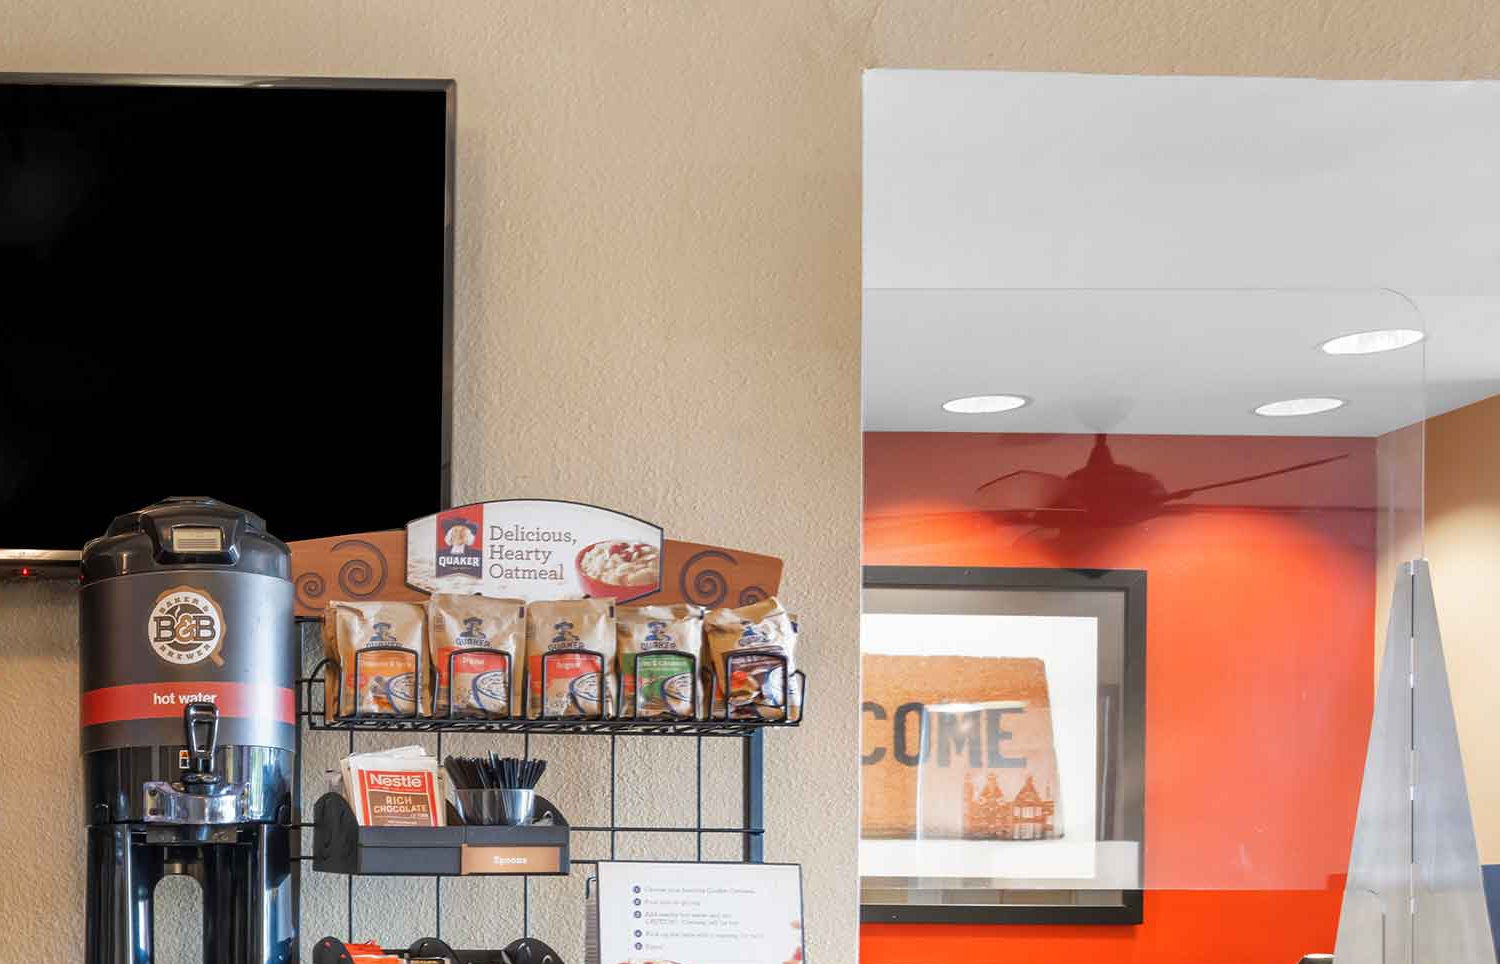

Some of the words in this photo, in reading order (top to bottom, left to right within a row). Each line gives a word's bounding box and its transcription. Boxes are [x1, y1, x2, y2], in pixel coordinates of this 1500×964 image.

[488, 525, 578, 545] Delicious,
[438, 555, 481, 568] QUAKER
[489, 544, 553, 566] Hearty
[488, 563, 565, 581] Oatmeal
[153, 613, 217, 643] B&B
[153, 692, 176, 705] hot
[179, 692, 218, 705] water
[385, 795, 413, 805] RICH
[373, 804, 428, 815] CHOCOLATE
